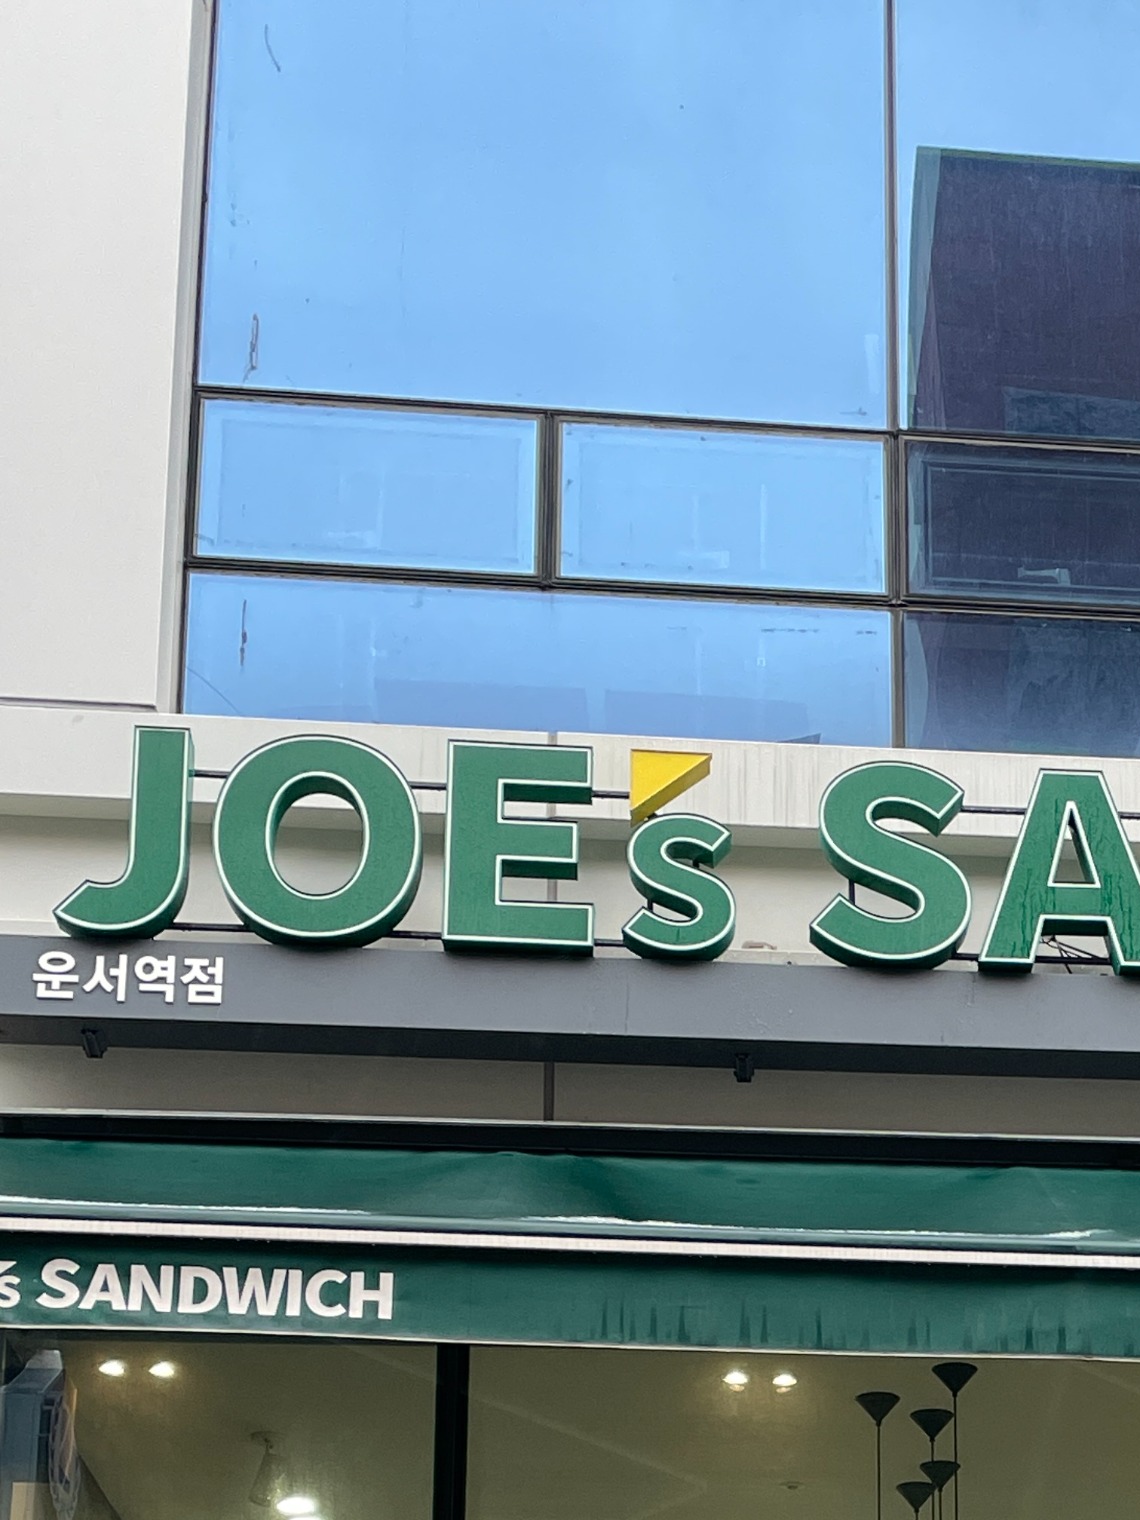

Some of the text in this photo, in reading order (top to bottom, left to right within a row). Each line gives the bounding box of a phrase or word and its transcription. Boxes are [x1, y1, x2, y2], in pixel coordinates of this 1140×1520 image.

[53, 724, 737, 962] JOE's
[31, 951, 226, 1005] 운서역점
[35, 1258, 394, 1320] SANDWICH
